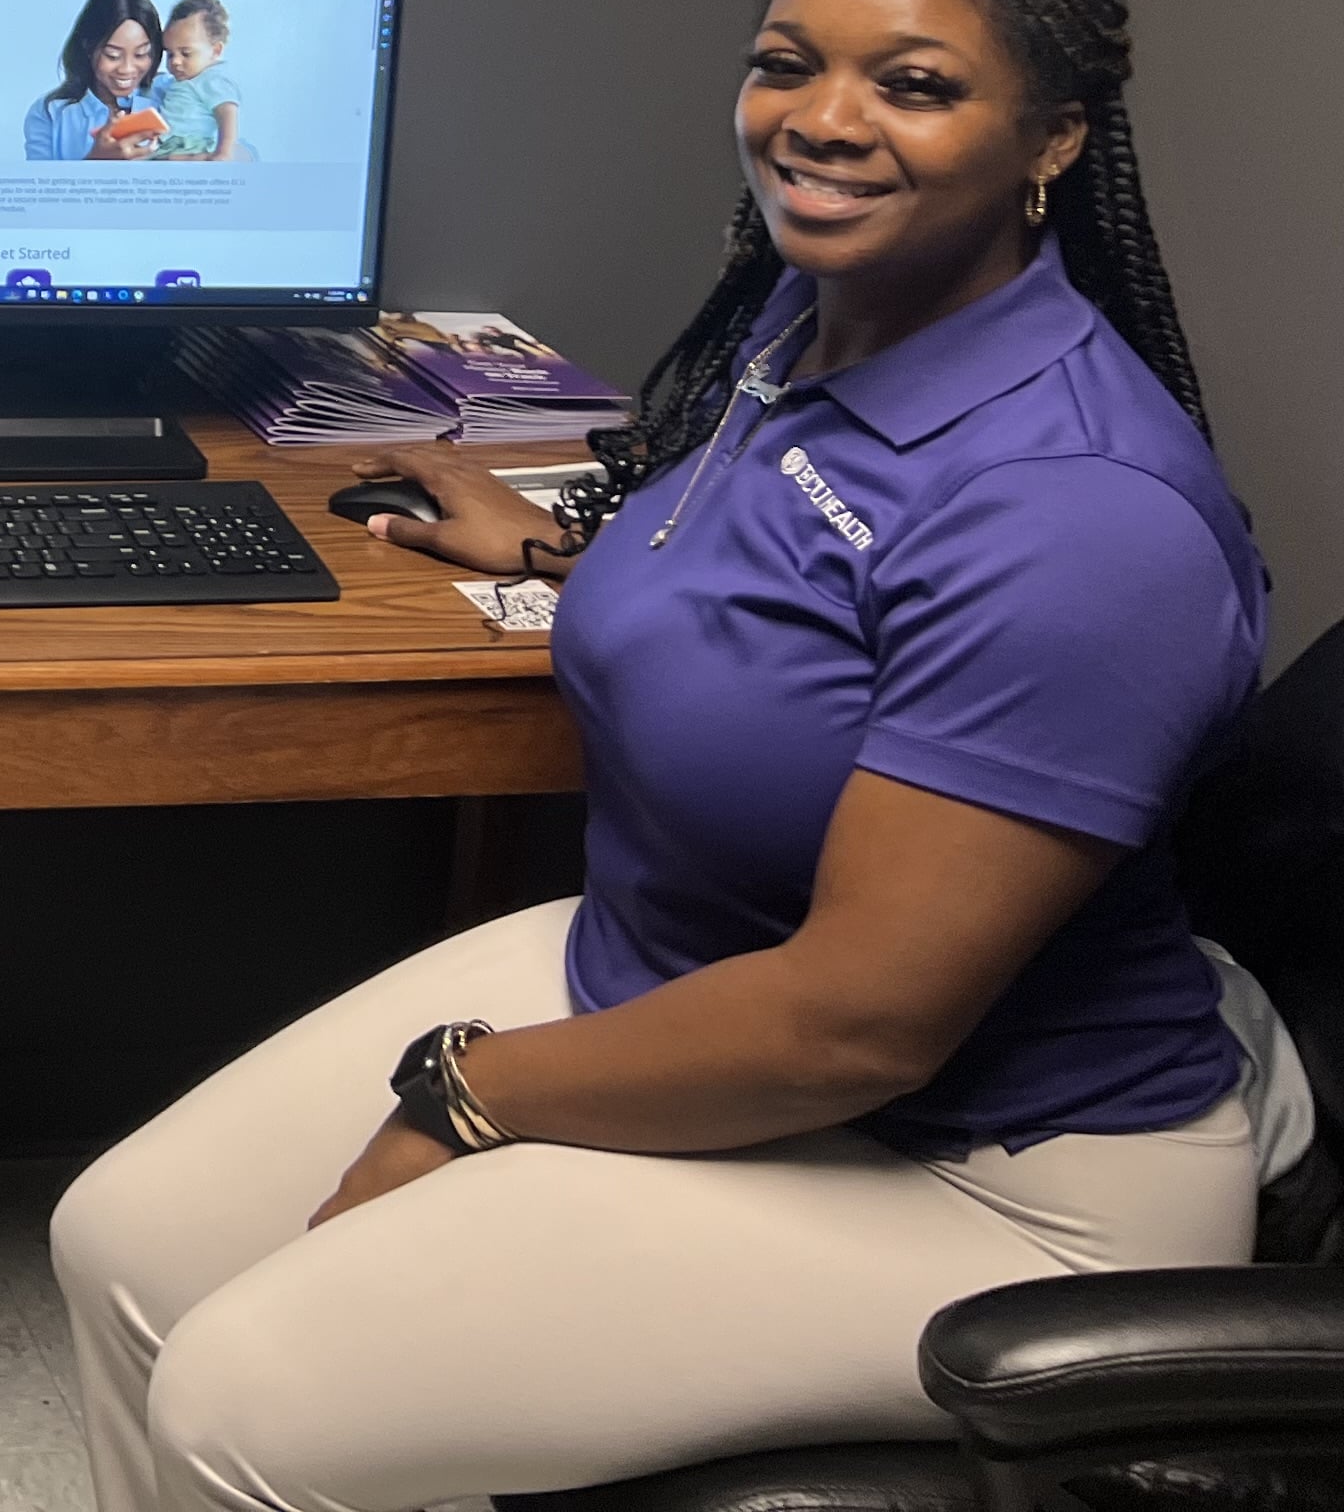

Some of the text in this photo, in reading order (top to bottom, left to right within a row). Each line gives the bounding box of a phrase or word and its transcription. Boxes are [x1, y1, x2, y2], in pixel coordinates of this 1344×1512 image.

[18, 246, 71, 260] Started
[795, 462, 874, 552] ECU HEALTH
